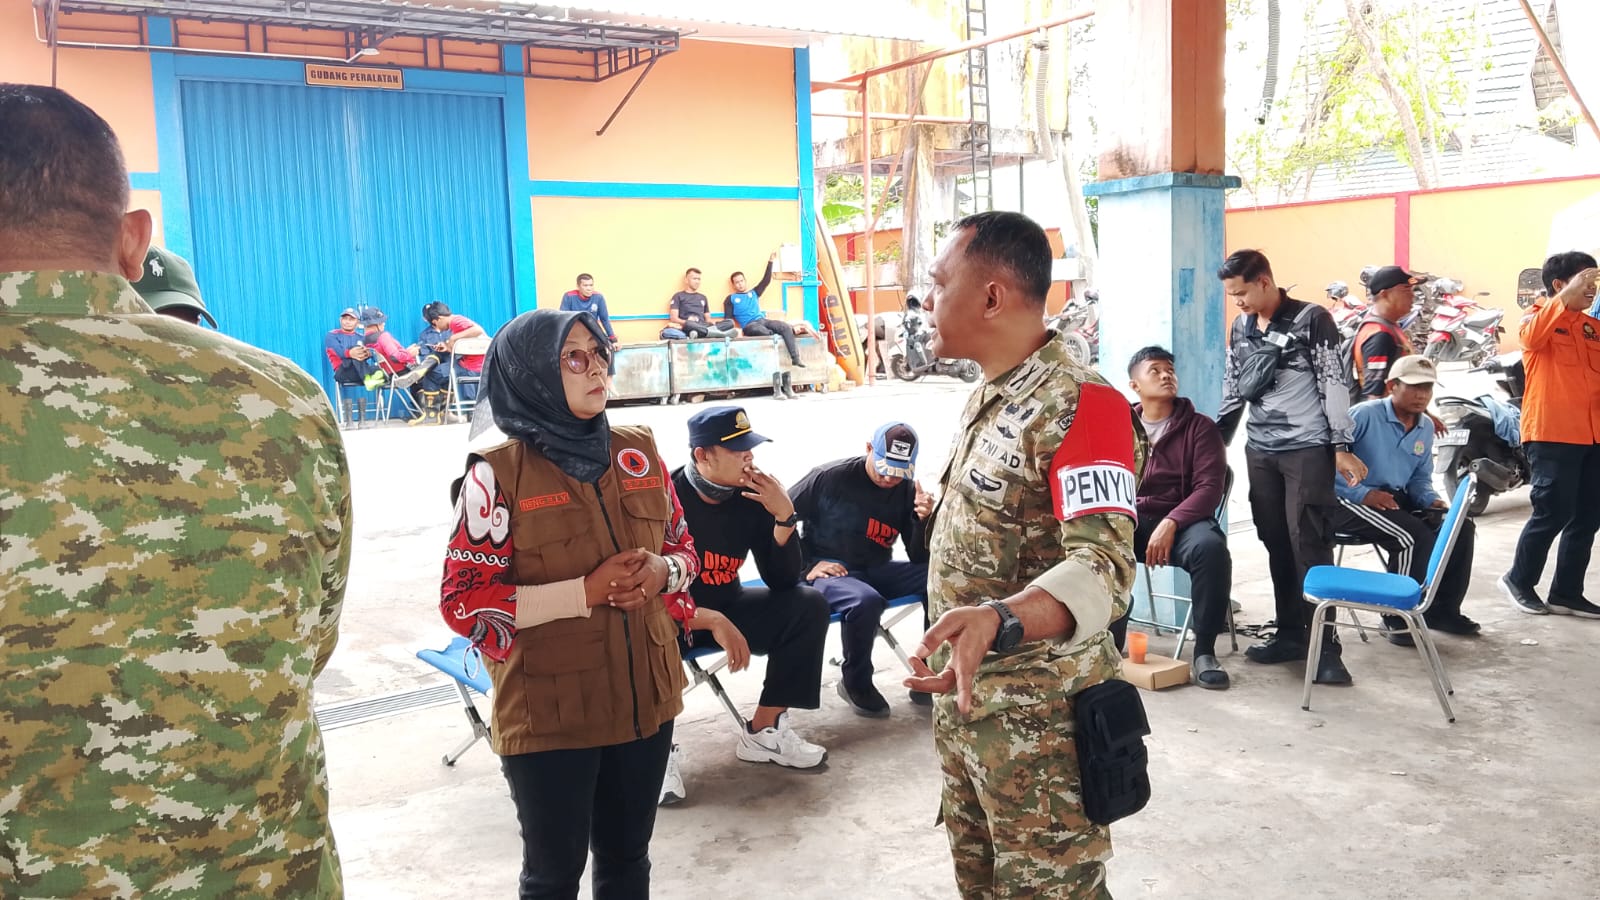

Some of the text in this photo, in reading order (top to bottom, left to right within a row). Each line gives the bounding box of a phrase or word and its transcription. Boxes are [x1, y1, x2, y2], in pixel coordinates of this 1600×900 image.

[310, 69, 399, 84] GUDANG PERALATAN
[981, 437, 1021, 470] TNI AD
[1065, 468, 1136, 509] PENYU
